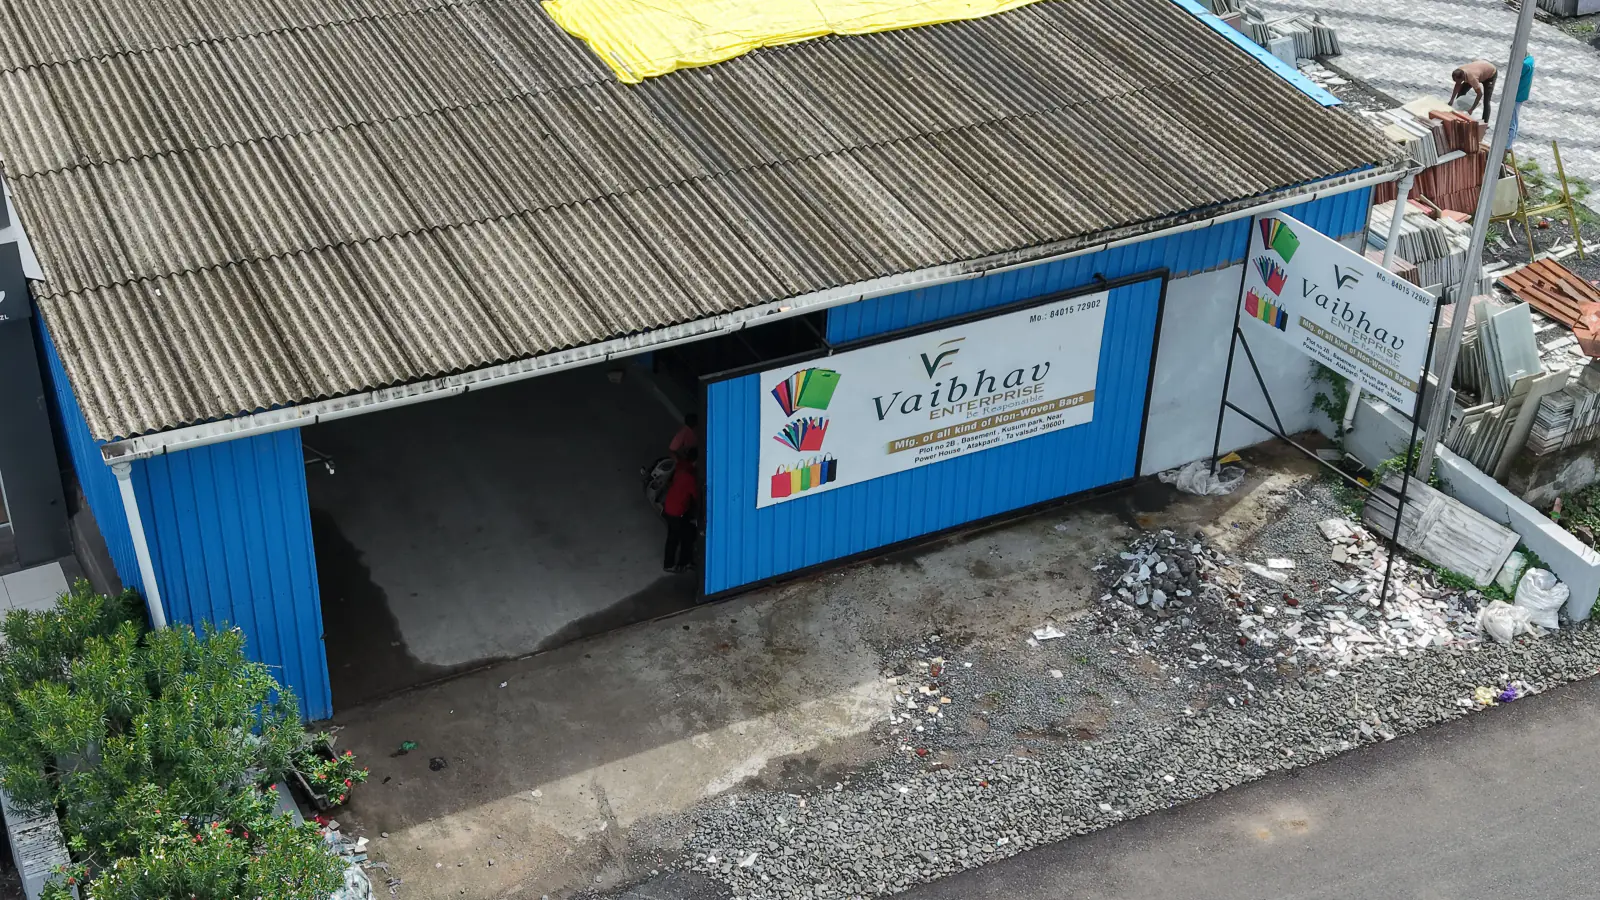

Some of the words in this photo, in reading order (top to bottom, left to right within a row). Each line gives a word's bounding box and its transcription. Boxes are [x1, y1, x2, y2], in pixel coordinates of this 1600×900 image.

[1050, 306, 1074, 318] 84015
[1077, 299, 1101, 311] 72902
[1391, 280, 1410, 295] 84015
[1301, 278, 1404, 350] Vaibhav
[1325, 333, 1334, 342] all
[1334, 338, 1348, 351] kind
[1357, 351, 1393, 377] Non-Woven
[1395, 373, 1411, 387] Bags
[1331, 316, 1402, 363] ENTERPRISE
[872, 361, 1050, 421] Vaibhav
[929, 382, 1045, 421] ENTERPRISE
[895, 438, 919, 450] Mfg.
[922, 433, 934, 443] of
[937, 428, 951, 439] all
[954, 421, 978, 434] kind
[981, 417, 992, 427] of
[995, 403, 1055, 424] Non-Woven
[1058, 395, 1084, 407] Bags
[919, 447, 933, 455] Plot
[961, 430, 996, 444] Basement
[1001, 423, 1026, 433] Kusum
[1046, 413, 1063, 421] Near
[914, 453, 937, 464] Power
[938, 447, 961, 457] House
[966, 437, 1000, 450] Atakpardi
[1015, 427, 1038, 437] valsad
